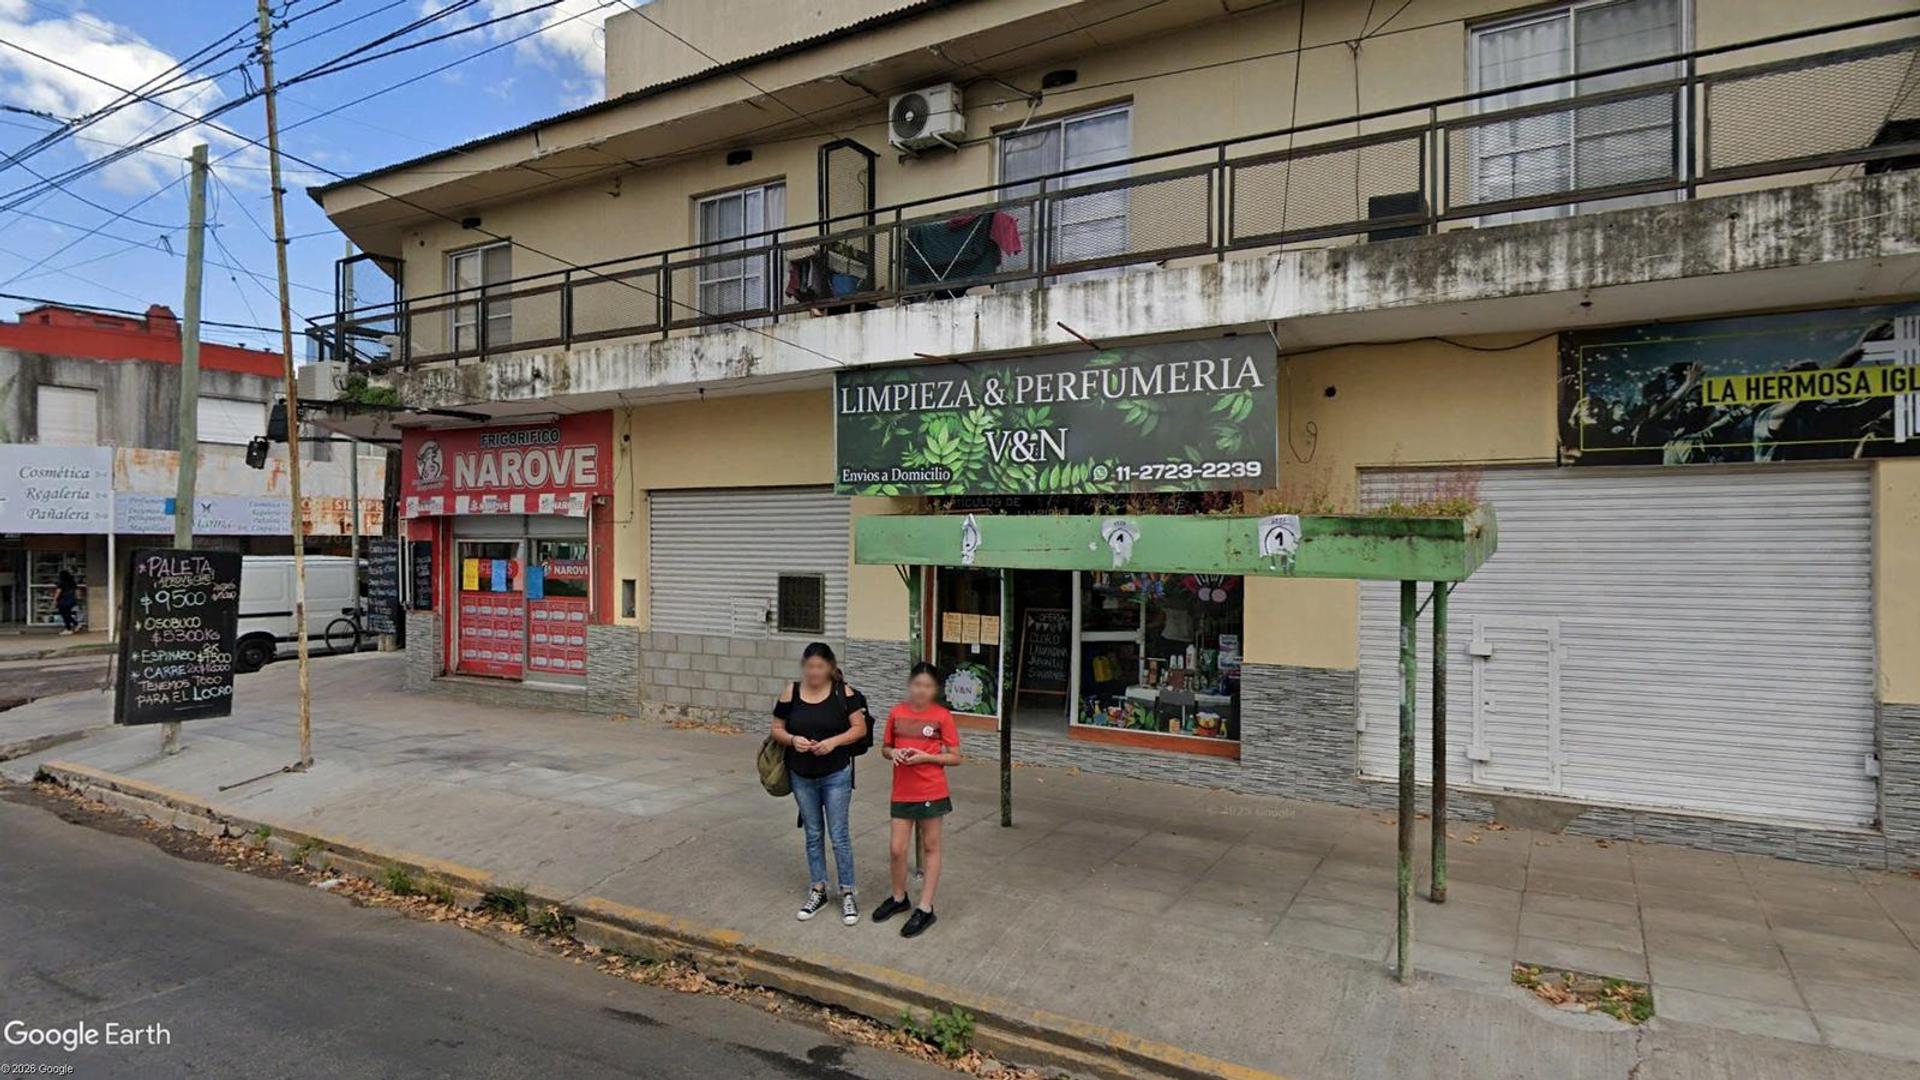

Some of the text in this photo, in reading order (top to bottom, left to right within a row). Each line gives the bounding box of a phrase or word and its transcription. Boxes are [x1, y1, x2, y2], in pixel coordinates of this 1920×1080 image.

[840, 355, 1264, 414] LIMPIEZA & PERFUMERIA
[1706, 379, 1737, 403] LA
[1746, 370, 1871, 401] HERMOSA
[480, 430, 561, 448] FRIGORIFICO
[985, 427, 1068, 462] V&N
[19, 465, 90, 479] Cosmética
[454, 446, 597, 489] NAROVE
[842, 467, 951, 482] Envios a Domicilio
[1115, 461, 1262, 481] 11-2723-2239
[26, 507, 90, 520] Pañalera
[1275, 531, 1283, 546] 1
[147, 556, 211, 577] PALETA
[136, 693, 169, 708] PARA
[173, 691, 189, 702] EL
